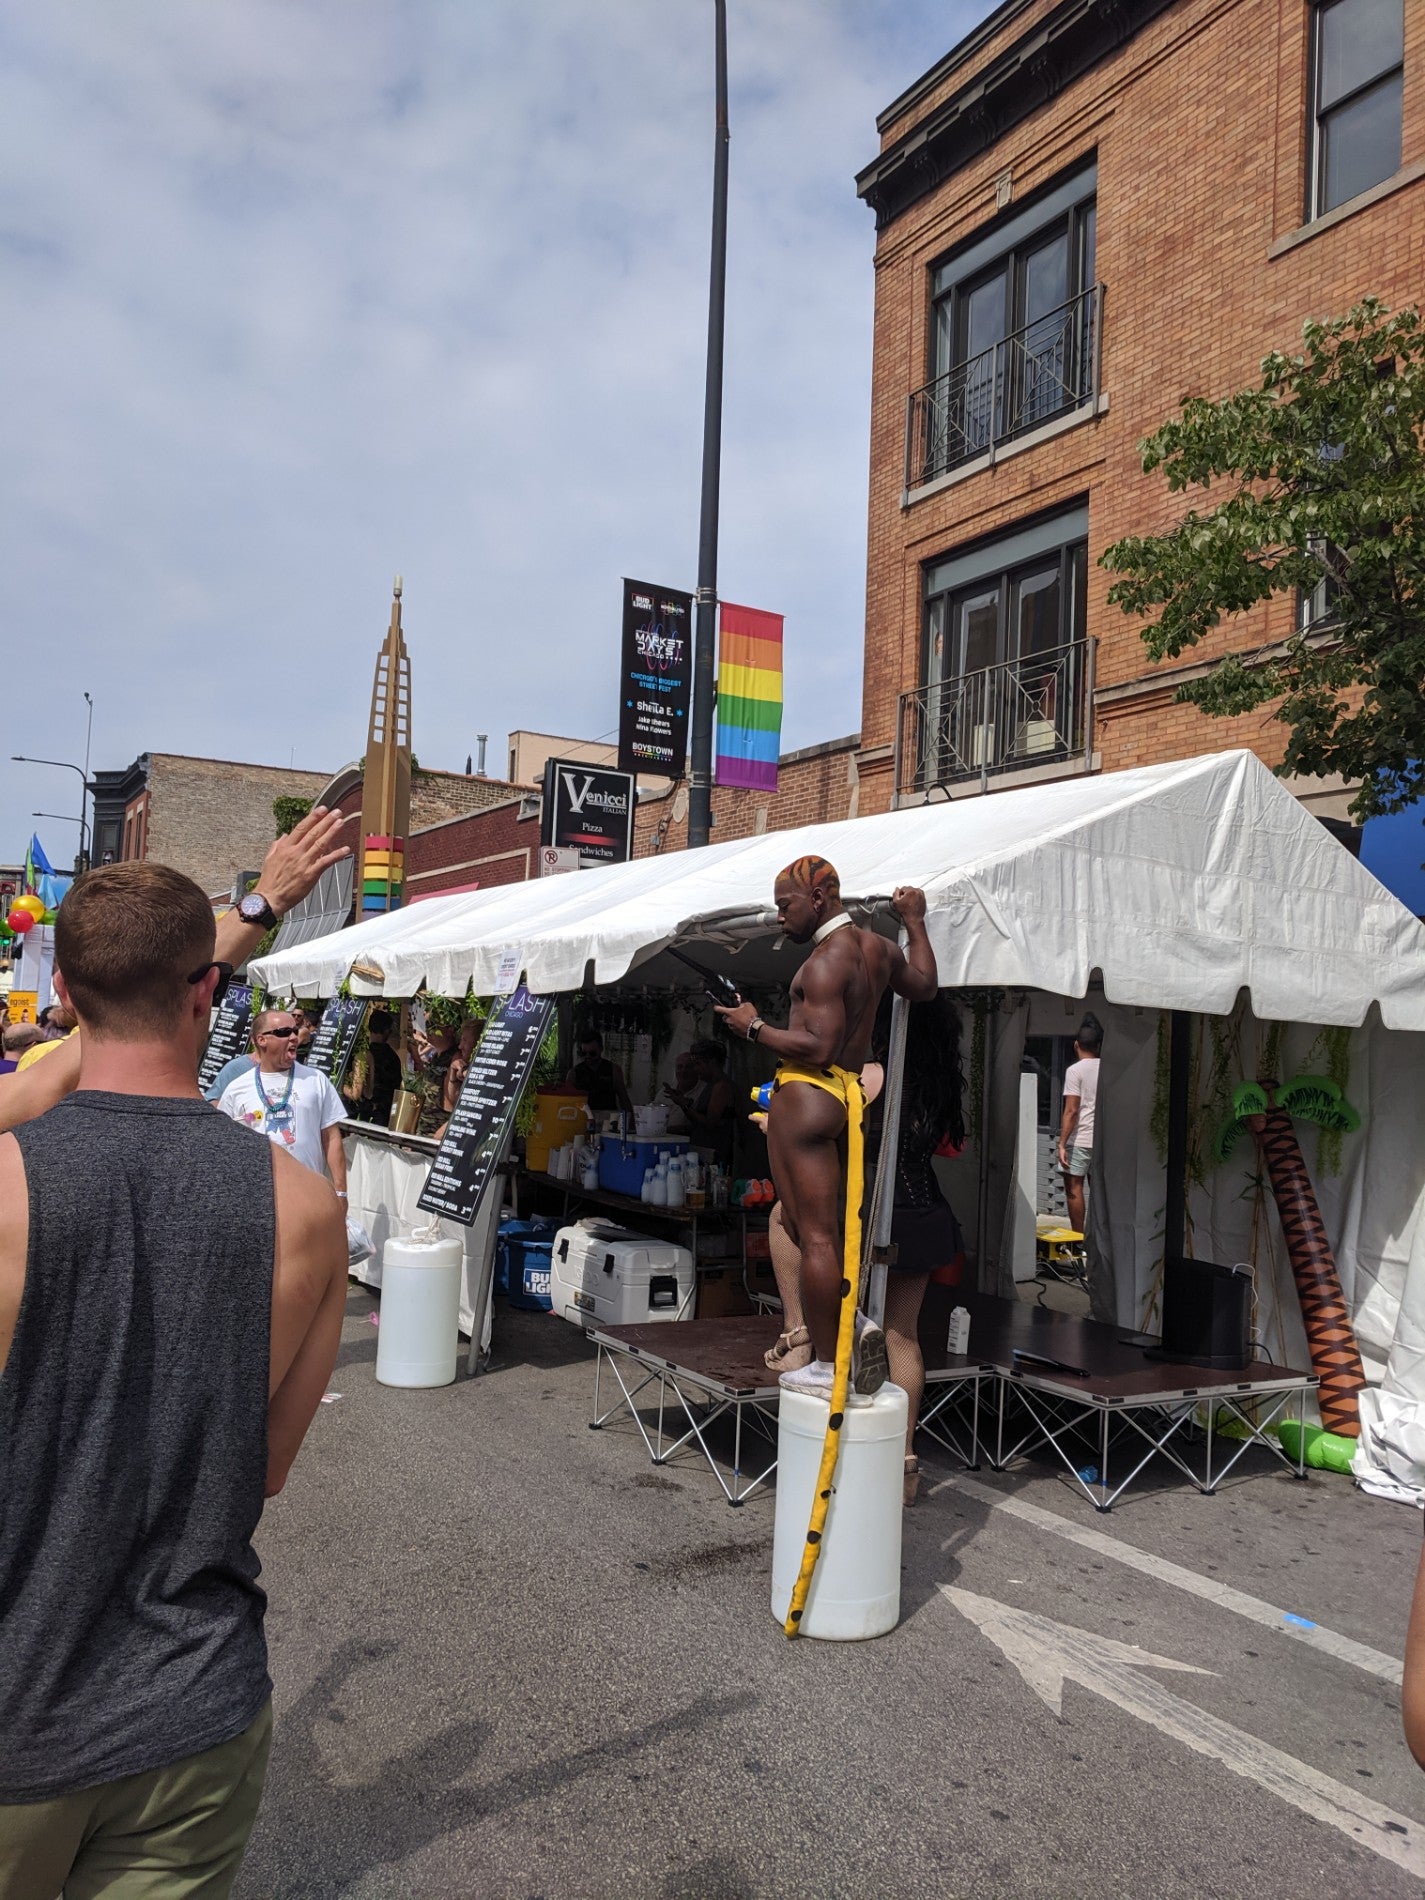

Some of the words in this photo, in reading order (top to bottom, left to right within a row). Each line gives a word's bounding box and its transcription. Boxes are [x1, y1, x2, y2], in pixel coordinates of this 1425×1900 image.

[632, 601, 652, 610] LIGHT
[635, 632, 684, 650] MARKET
[632, 742, 674, 756] BOYSTOWN
[561, 772, 628, 814] Venicci
[602, 807, 627, 816] ITALIAN
[582, 822, 603, 833] Pizza
[568, 844, 615, 858] Sndwiches
[531, 1272, 550, 1284] BU
